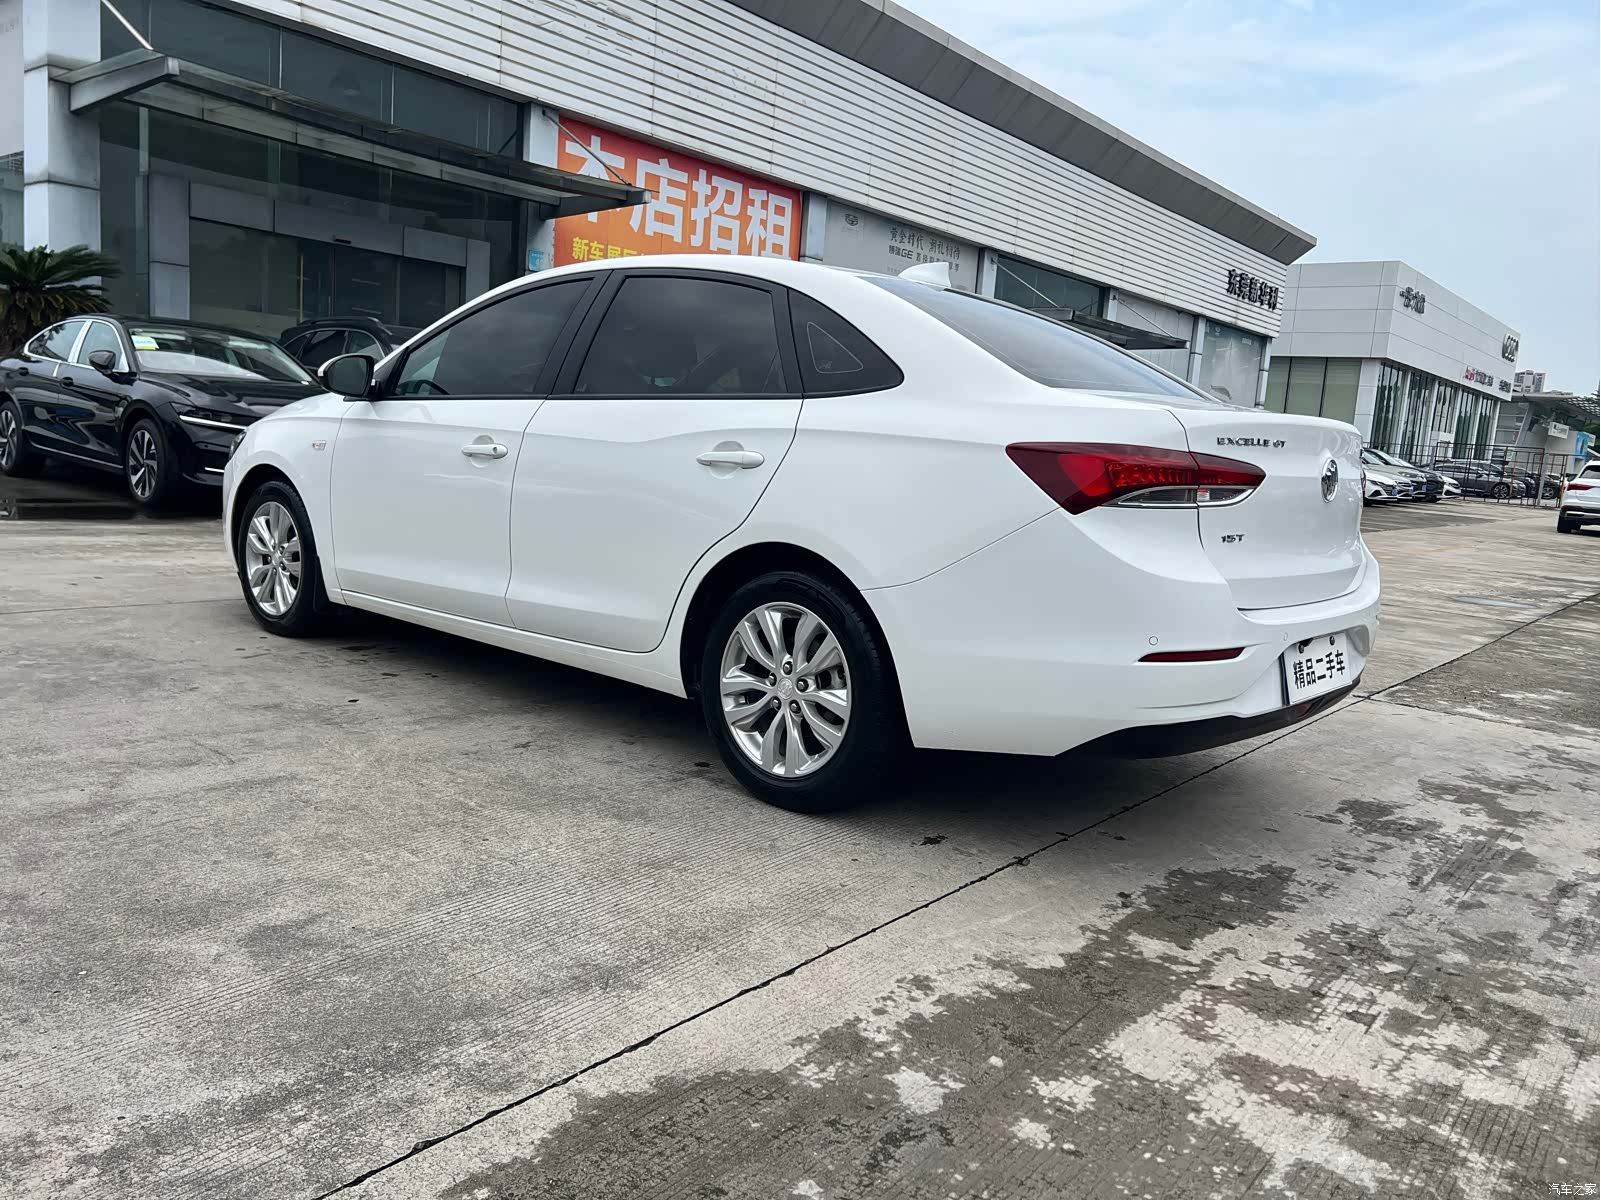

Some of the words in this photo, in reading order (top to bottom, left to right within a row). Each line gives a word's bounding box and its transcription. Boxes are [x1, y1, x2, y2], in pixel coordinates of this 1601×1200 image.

[565, 134, 793, 261] 本店招租
[1216, 436, 1271, 448] EXCELLE
[1292, 649, 1346, 690] 精品二手车
